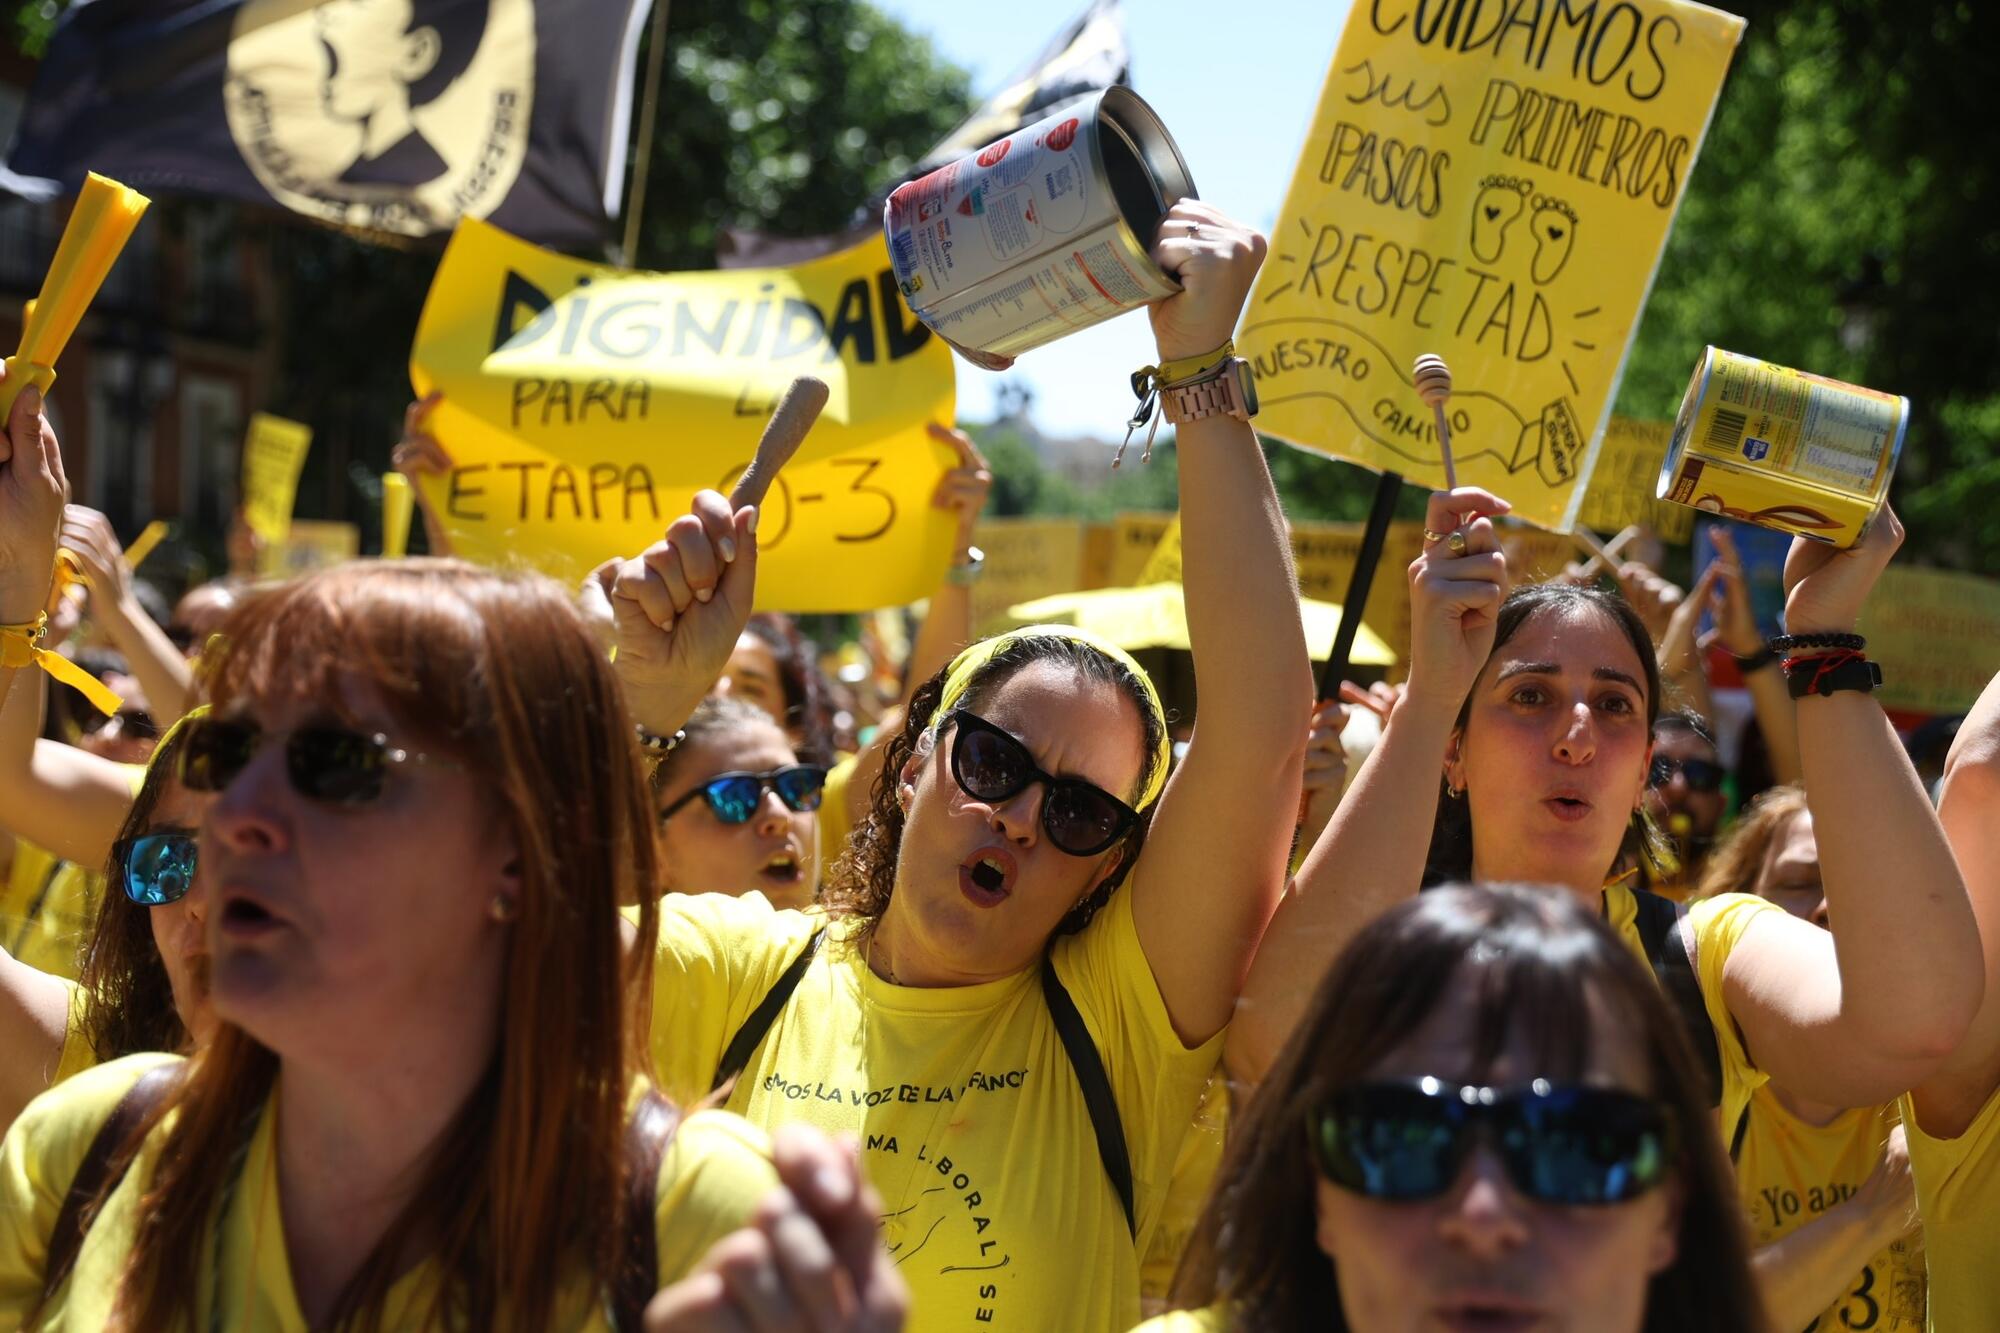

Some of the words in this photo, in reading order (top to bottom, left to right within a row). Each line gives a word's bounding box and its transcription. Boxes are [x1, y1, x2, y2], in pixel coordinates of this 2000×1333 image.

[1319, 121, 1451, 218] PASOS
[1469, 78, 1689, 209] PRIMEROS
[1299, 224, 1553, 362] RESPETAD
[511, 376, 652, 429] PARA
[446, 460, 660, 522] ETAPA
[815, 1082, 843, 1103] LA
[850, 1086, 895, 1108] VOZ
[897, 1084, 920, 1103] DE
[924, 1086, 955, 1103] LA
[917, 1144, 998, 1257] LBORAL
[1760, 1184, 1799, 1228] Yo
